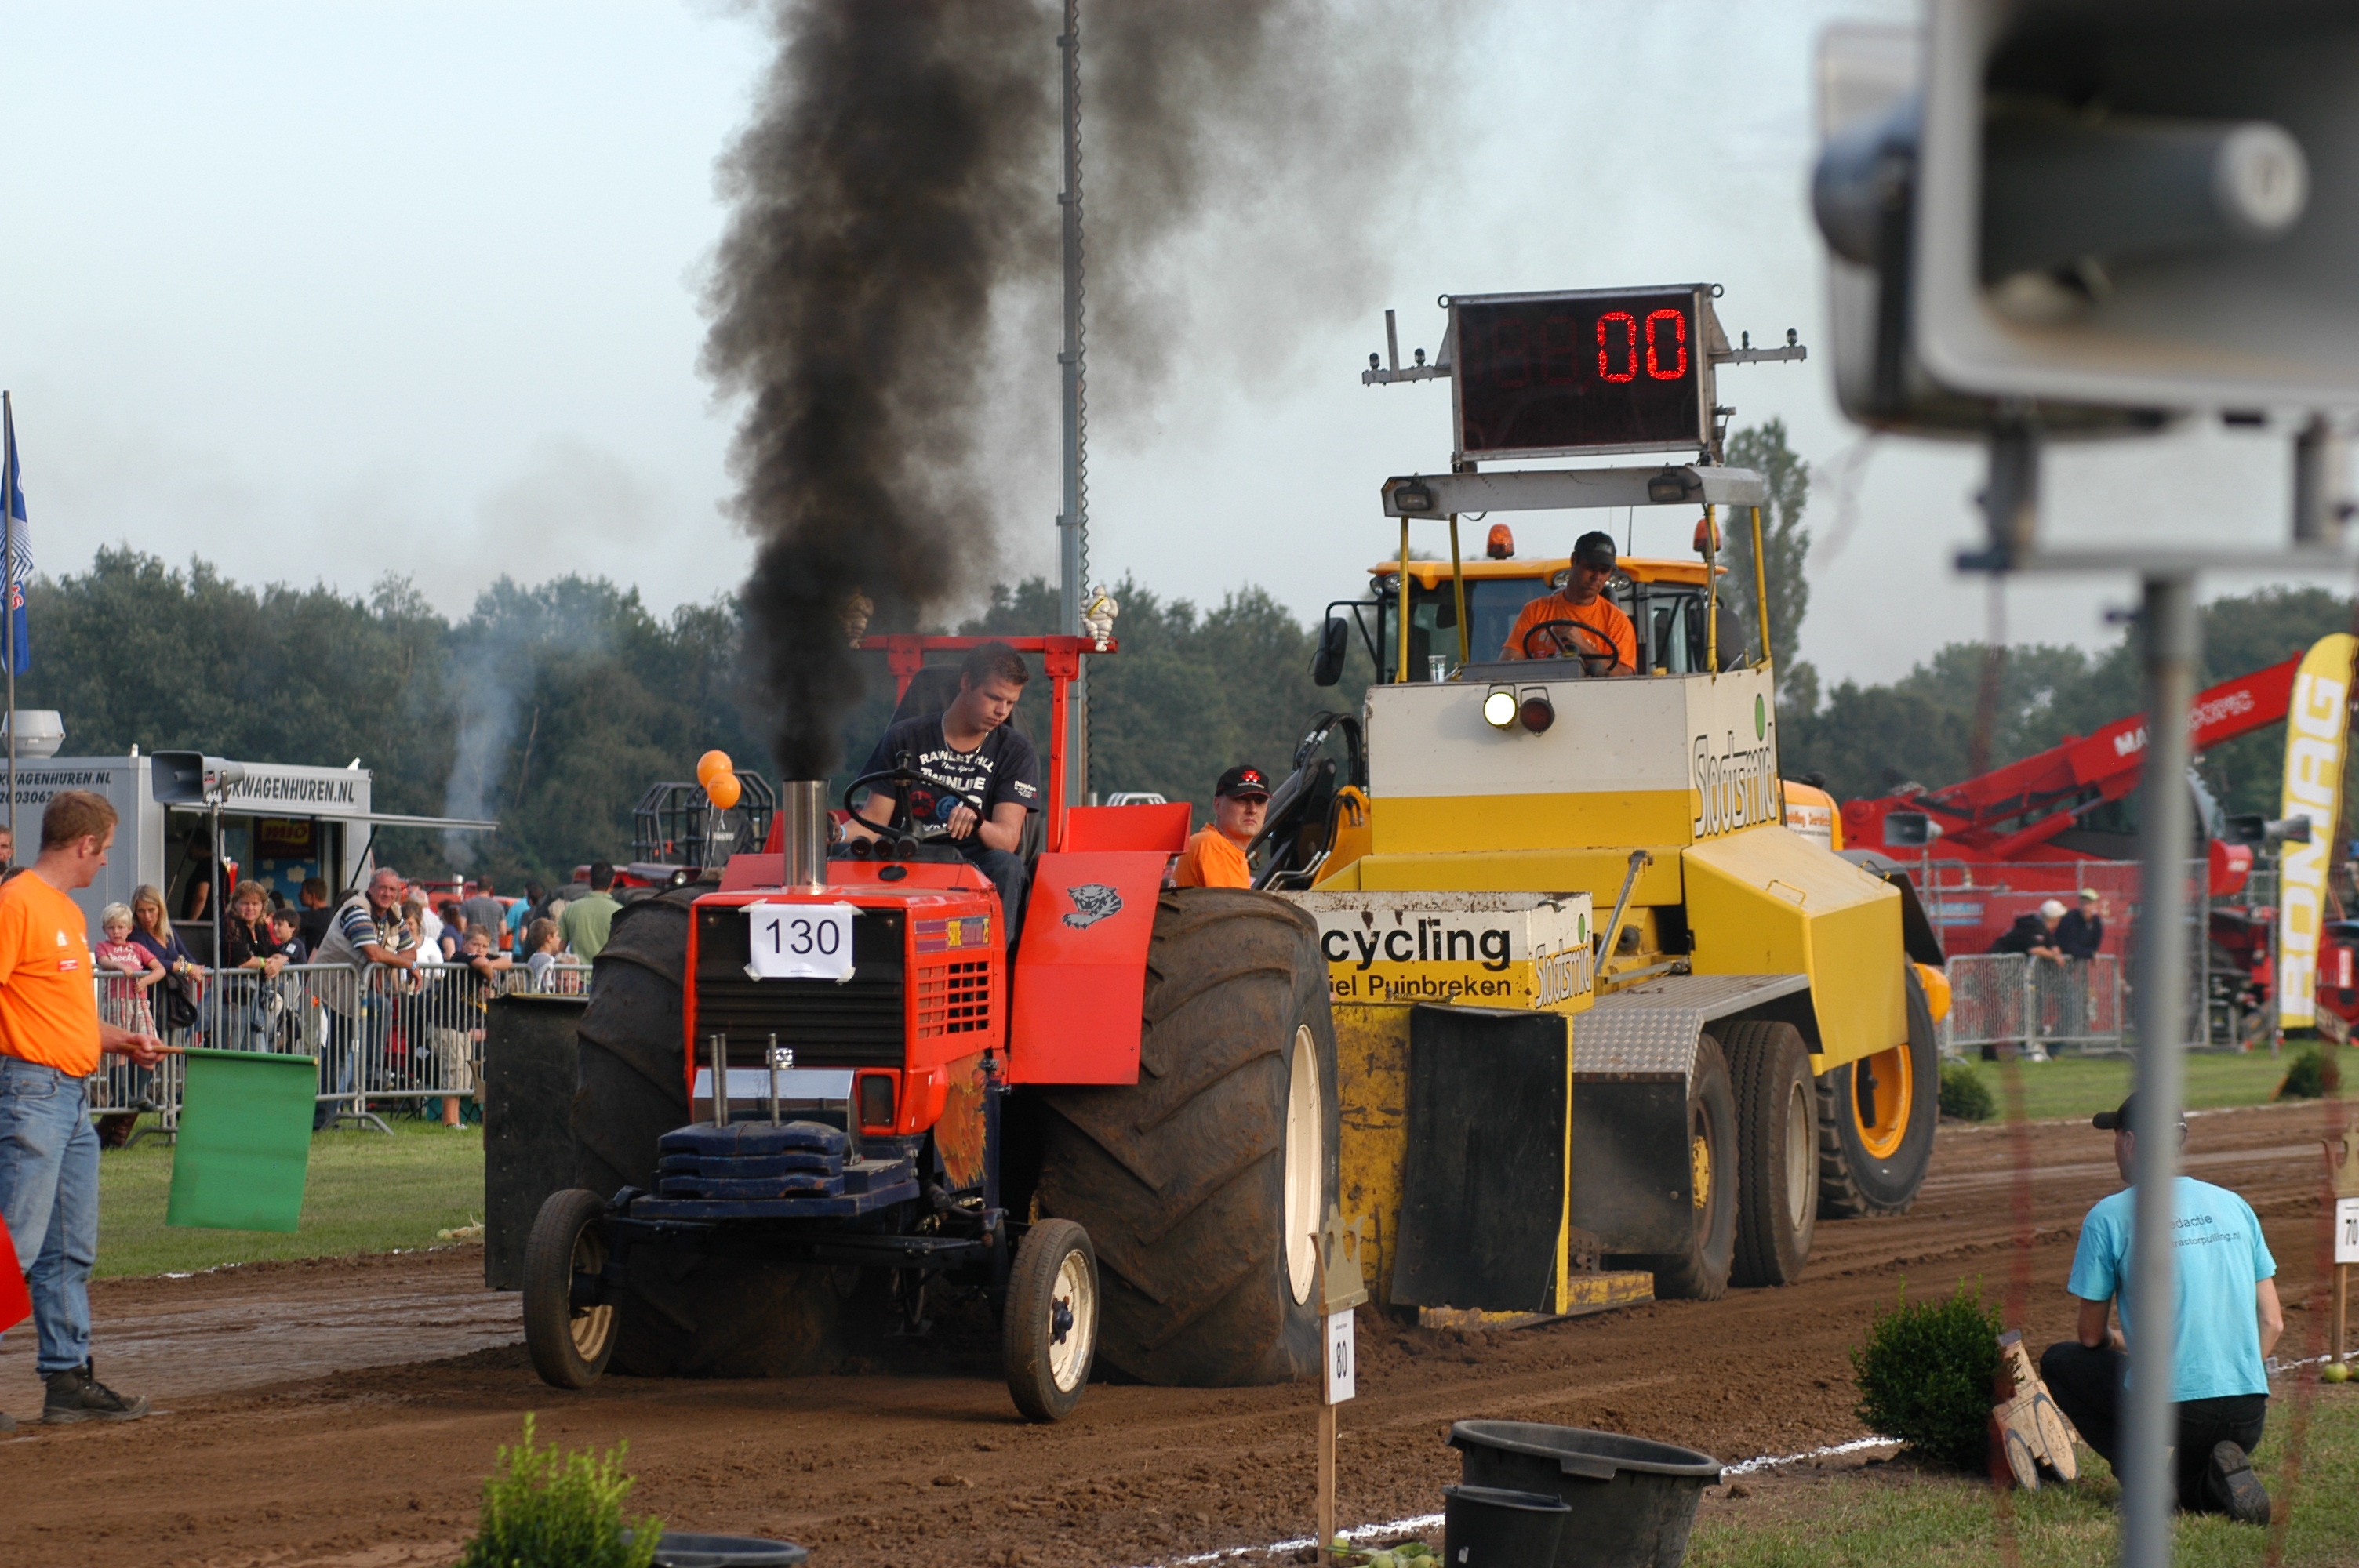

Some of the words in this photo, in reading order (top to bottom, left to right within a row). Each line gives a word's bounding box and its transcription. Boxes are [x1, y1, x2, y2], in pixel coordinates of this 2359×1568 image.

[1597, 309, 1687, 383] 00
[1693, 693, 1777, 839] Slootsmid
[2280, 673, 2345, 1016] BOMAG
[766, 918, 839, 955] 130
[1321, 919, 1510, 971] cycling
[1536, 913, 1592, 1009] Slootsmid
[1369, 975, 1511, 996] Puinbreken
[2168, 1213, 2213, 1229] edactie
[2346, 1219, 2358, 1246] 70
[1336, 1340, 1347, 1380] 80
